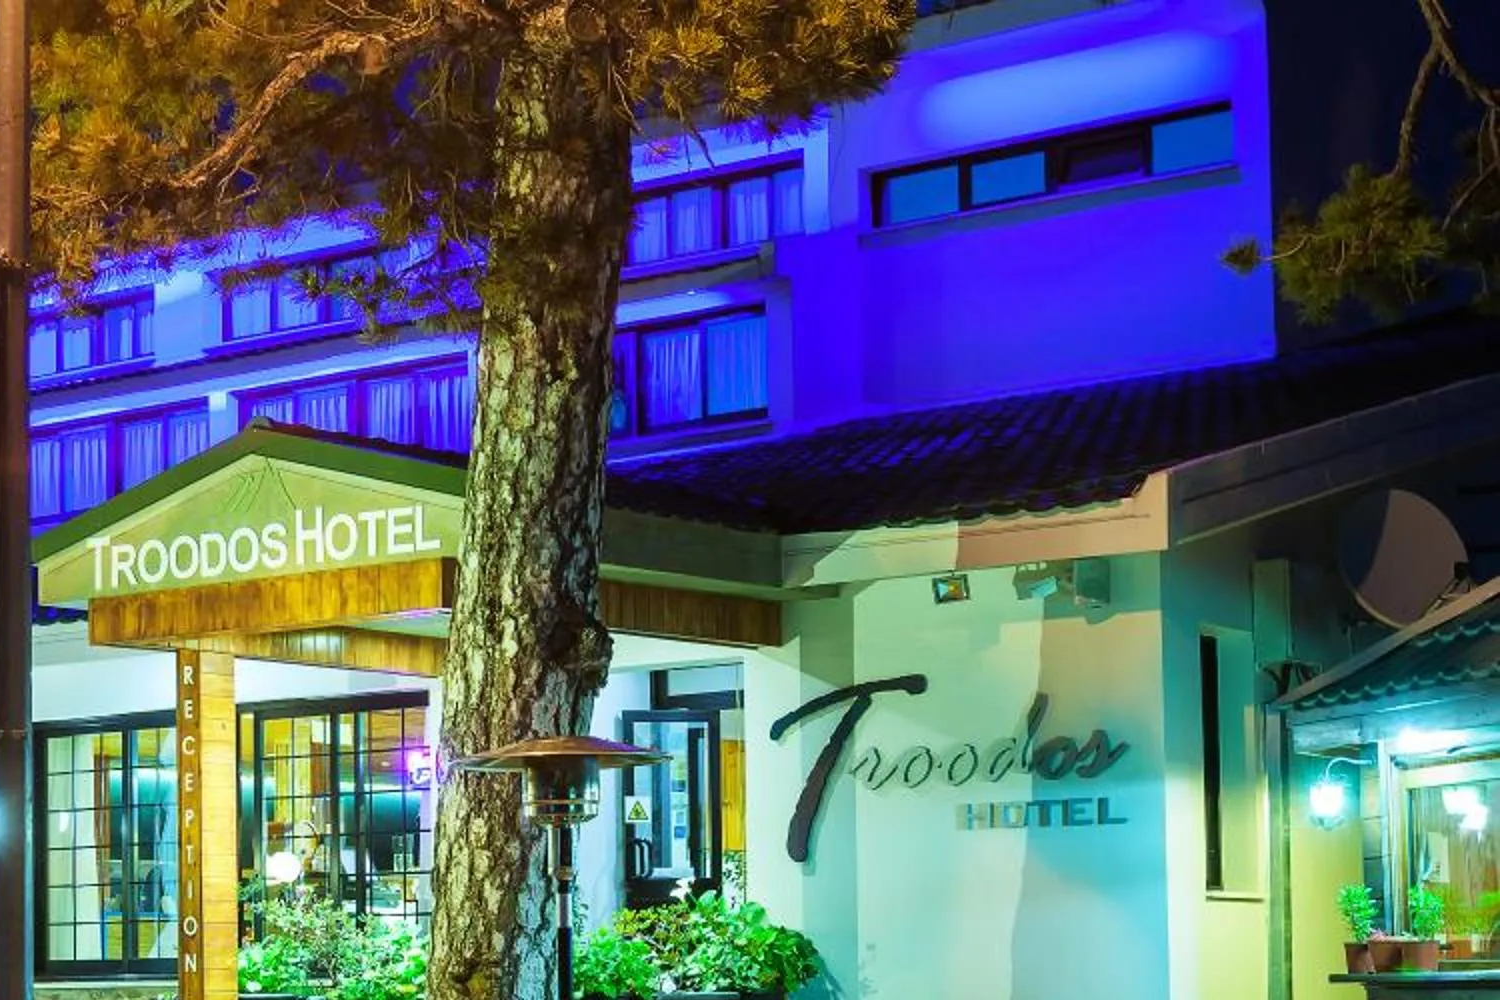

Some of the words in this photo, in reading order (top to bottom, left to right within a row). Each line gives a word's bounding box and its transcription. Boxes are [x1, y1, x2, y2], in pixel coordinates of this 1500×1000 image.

[87, 523, 288, 590] TROODOS
[295, 504, 441, 566] HOTEL
[182, 664, 197, 974] RECEPTION
[769, 673, 1130, 863] Troodos
[955, 796, 1129, 831] HOTEL
